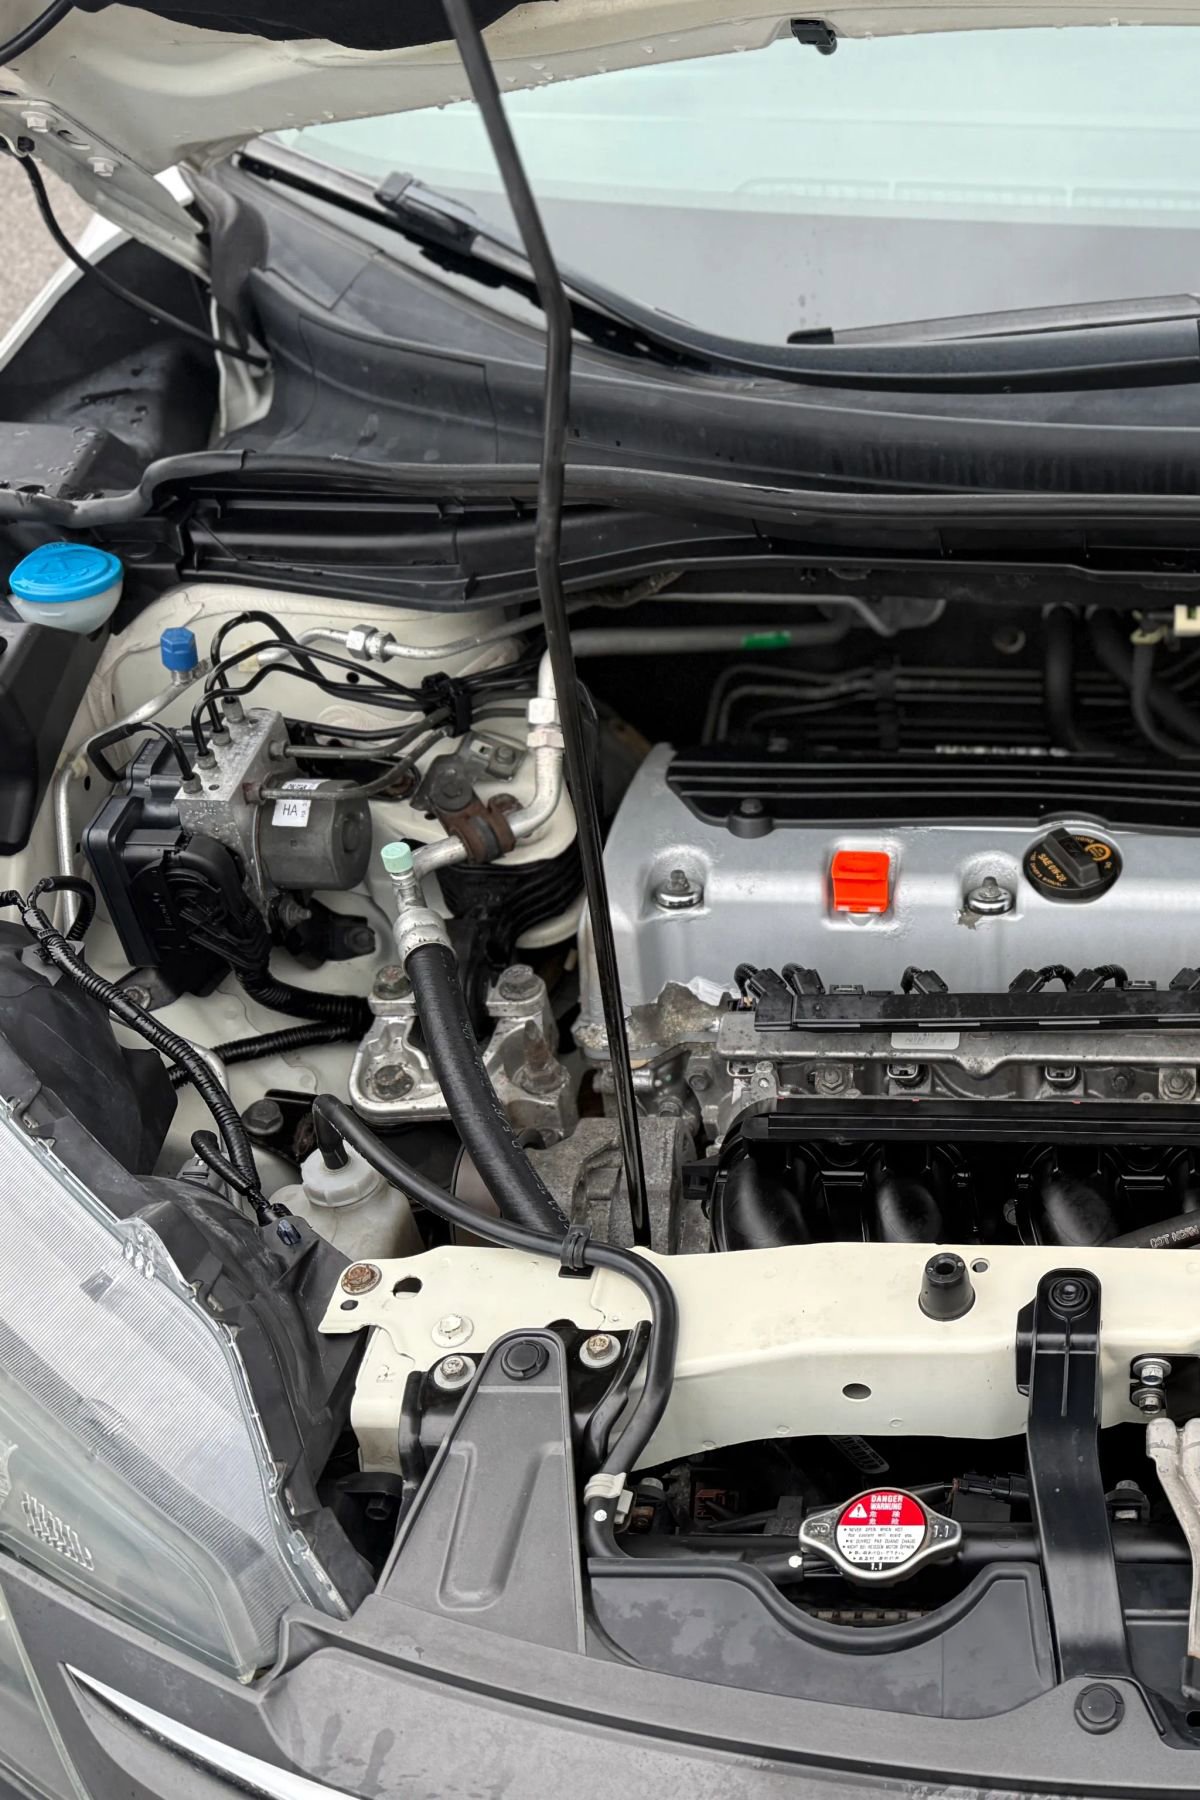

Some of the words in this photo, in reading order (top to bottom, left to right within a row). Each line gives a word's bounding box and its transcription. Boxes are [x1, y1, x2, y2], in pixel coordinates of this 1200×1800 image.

[282, 803, 298, 816] HA
[1038, 853, 1052, 867] SAE
[870, 1494, 904, 1503] DANGER
[933, 1525, 949, 1538] 1.1
[870, 1562, 883, 1571] 1.1
